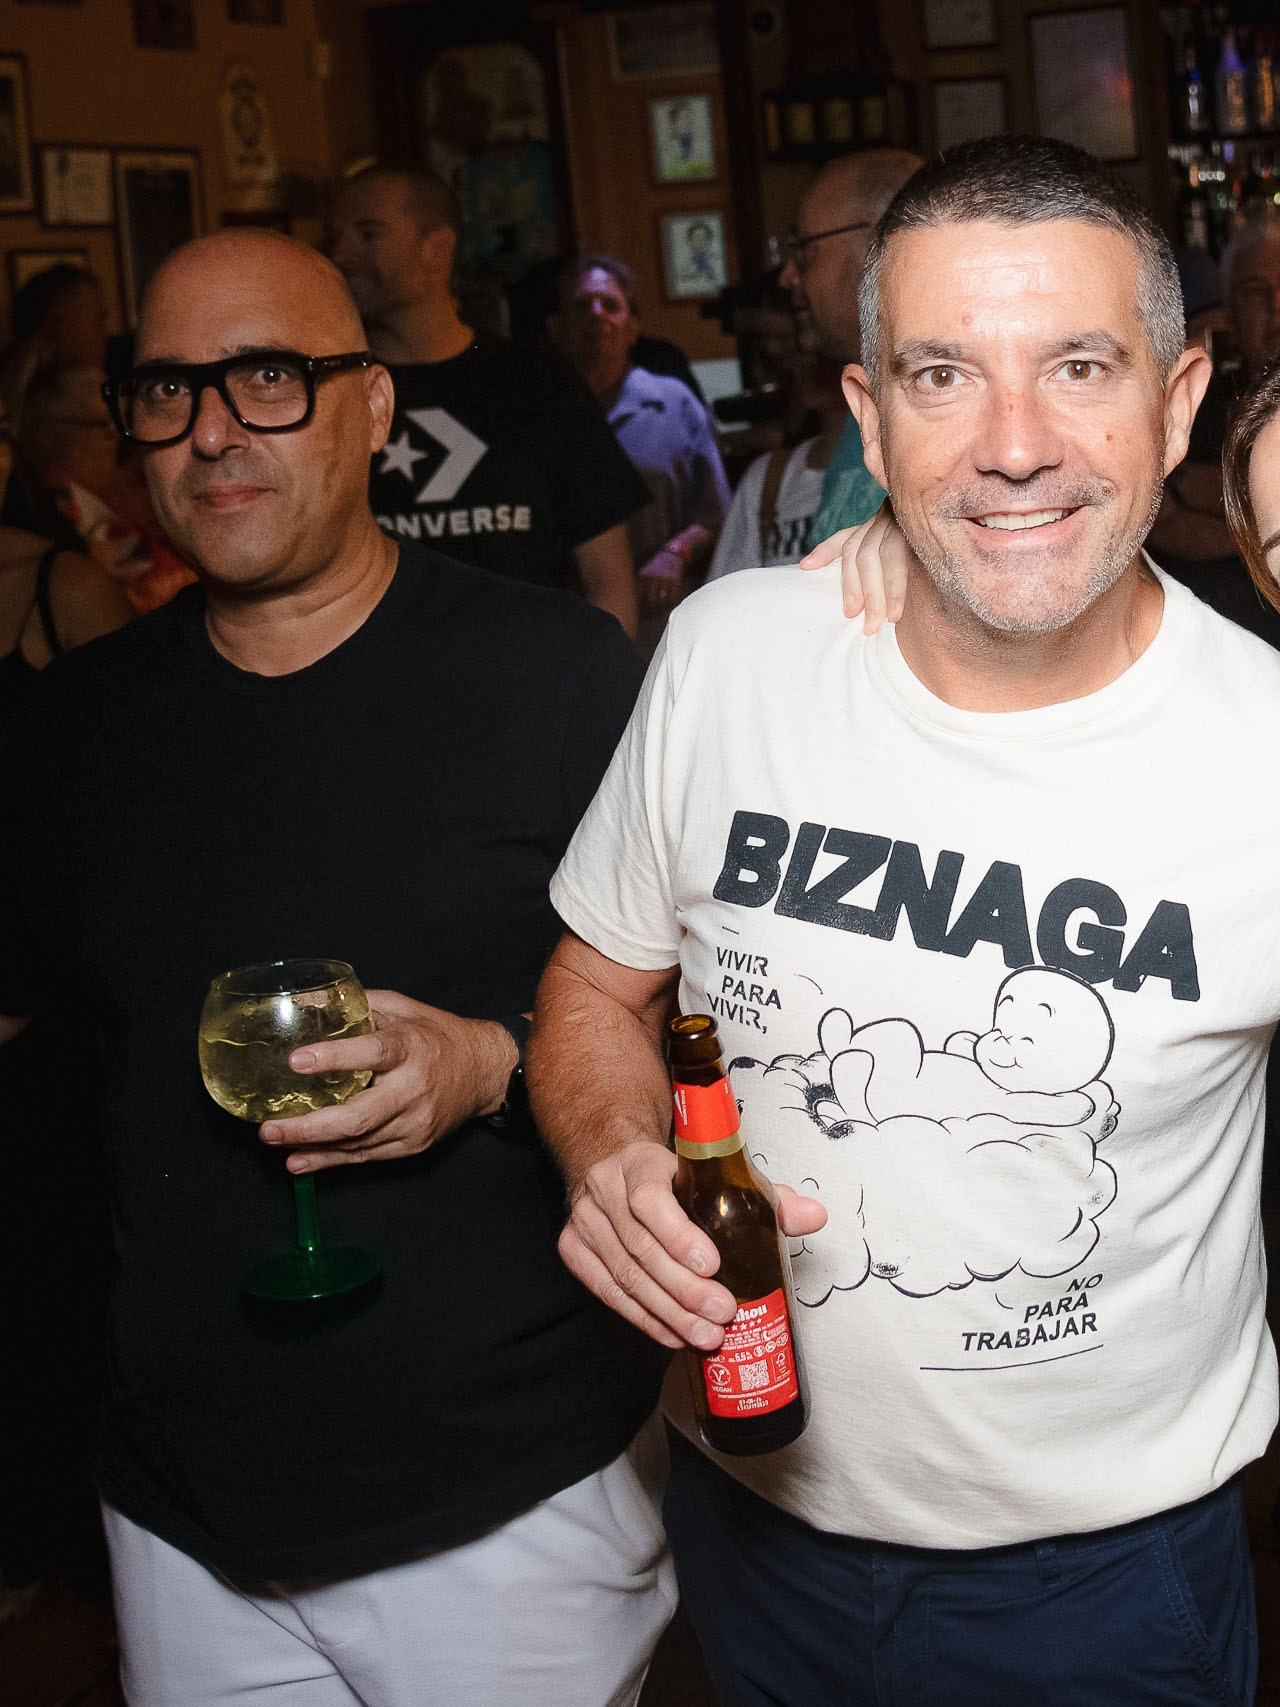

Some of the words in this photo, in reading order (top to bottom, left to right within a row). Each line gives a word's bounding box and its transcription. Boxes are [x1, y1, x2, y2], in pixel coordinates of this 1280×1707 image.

[712, 809, 1200, 1002] BIZNAGA
[716, 946, 769, 977] VIVIR
[721, 974, 782, 1010] PARA
[706, 992, 767, 1034] VIVIR,
[1065, 1273, 1104, 1293] NO
[1023, 1291, 1089, 1324] PARA
[961, 1312, 1098, 1351] TRABAJAR
